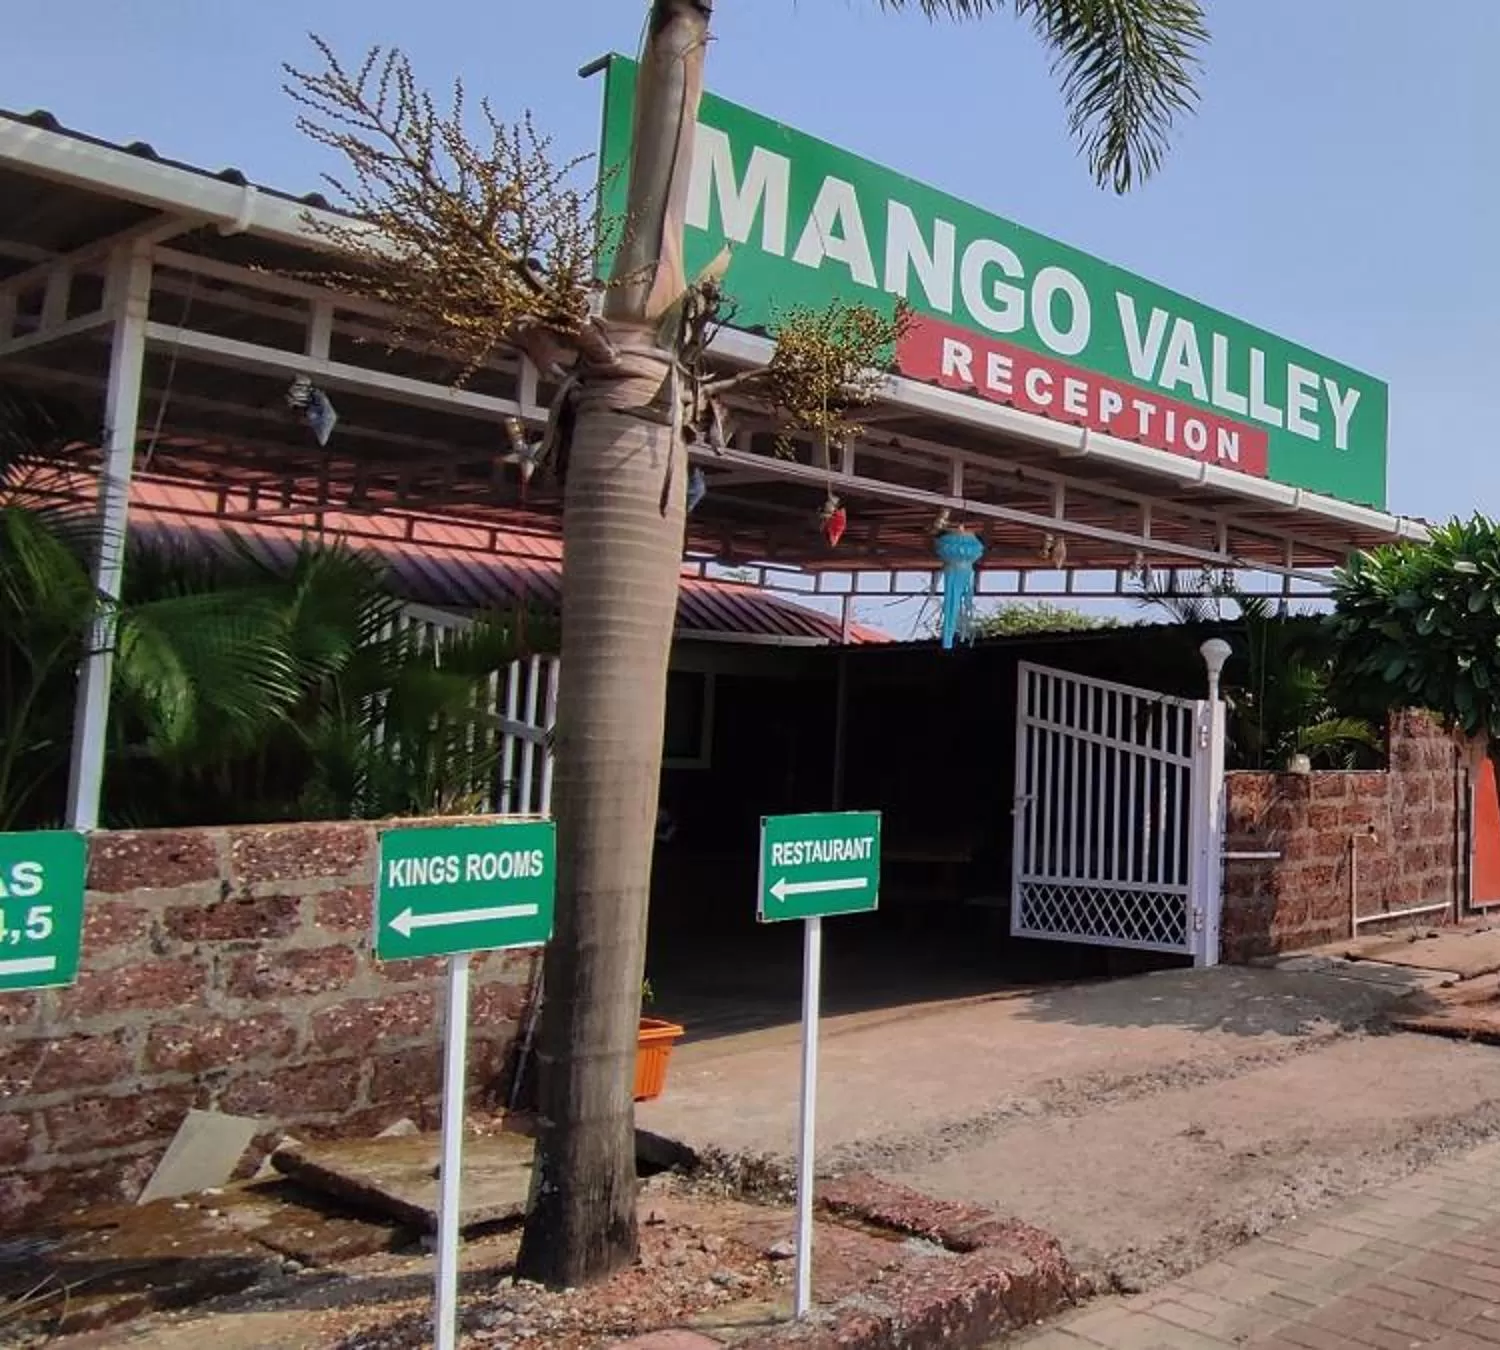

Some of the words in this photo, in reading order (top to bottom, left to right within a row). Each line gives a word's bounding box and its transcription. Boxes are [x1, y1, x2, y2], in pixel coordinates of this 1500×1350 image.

[684, 120, 1091, 356] MANGO
[1117, 290, 1360, 451] VALLEY
[941, 336, 1241, 463] RECEPTION
[388, 855, 460, 888] KINGS
[465, 849, 544, 881] ROOMS
[771, 837, 875, 867] RESTAURANT
[0, 861, 44, 897] S
